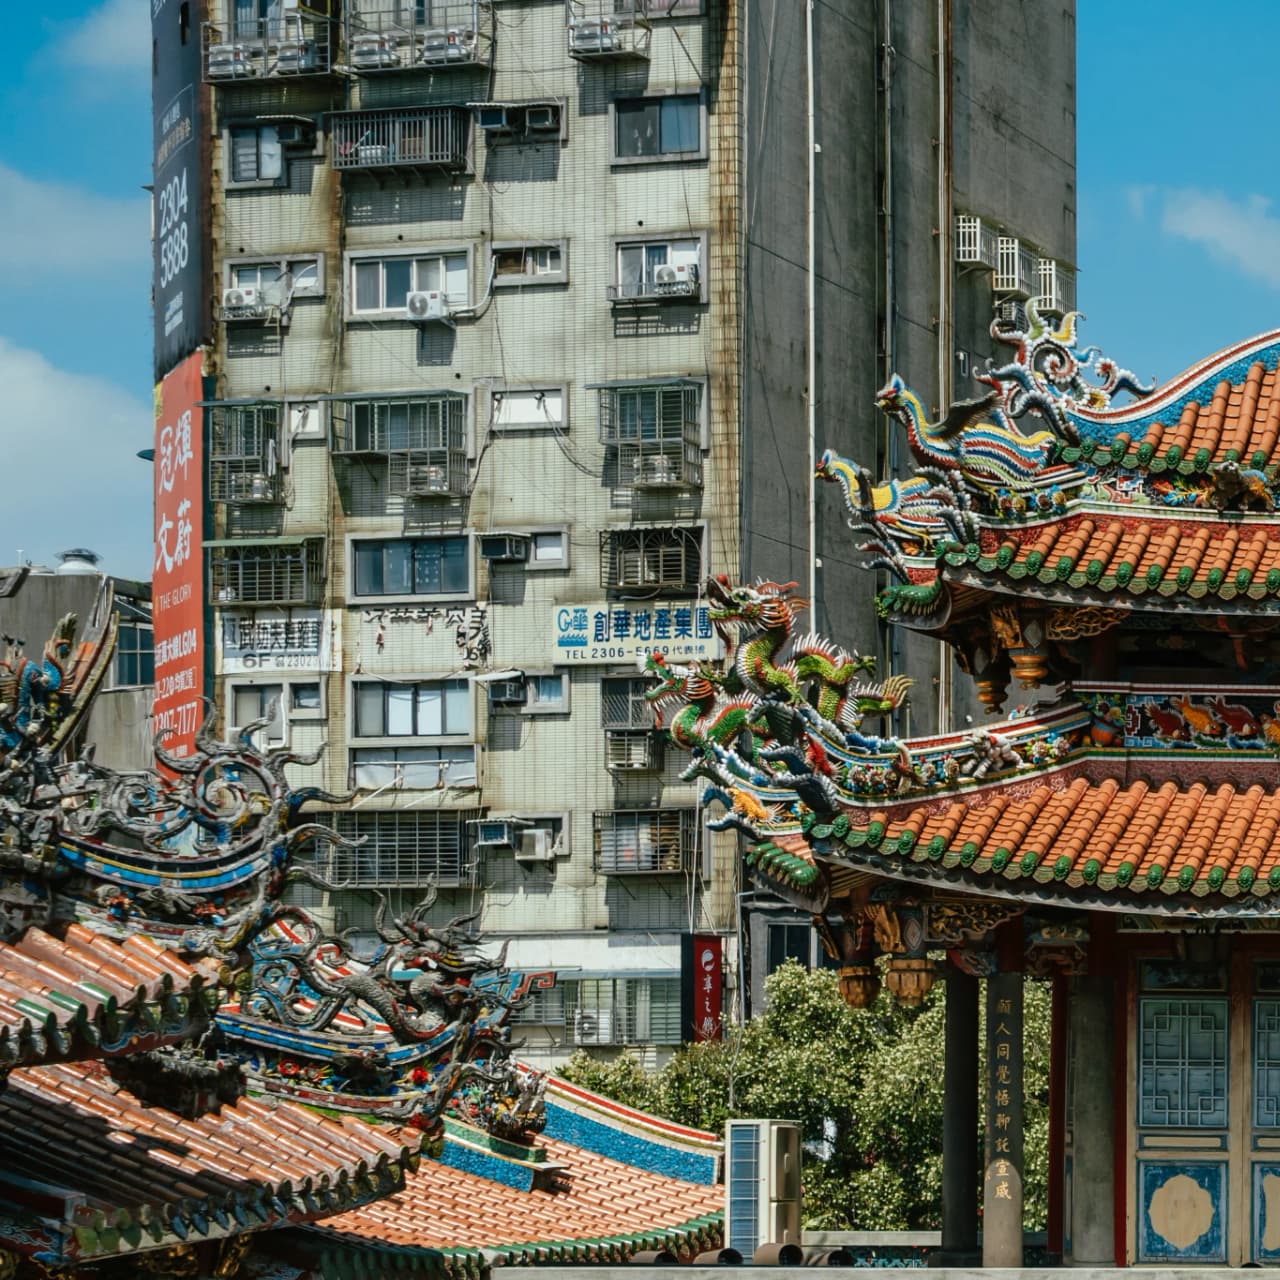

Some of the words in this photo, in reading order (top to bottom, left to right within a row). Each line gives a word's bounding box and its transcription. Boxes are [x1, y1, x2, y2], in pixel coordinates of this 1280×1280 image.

[160, 167, 188, 239] 2304
[161, 221, 188, 288] 5888
[159, 593, 171, 611] THE
[172, 583, 192, 607] GLORY
[593, 607, 713, 642] 創華地產集團
[242, 653, 271, 668] 6F
[565, 650, 587, 659] TEL
